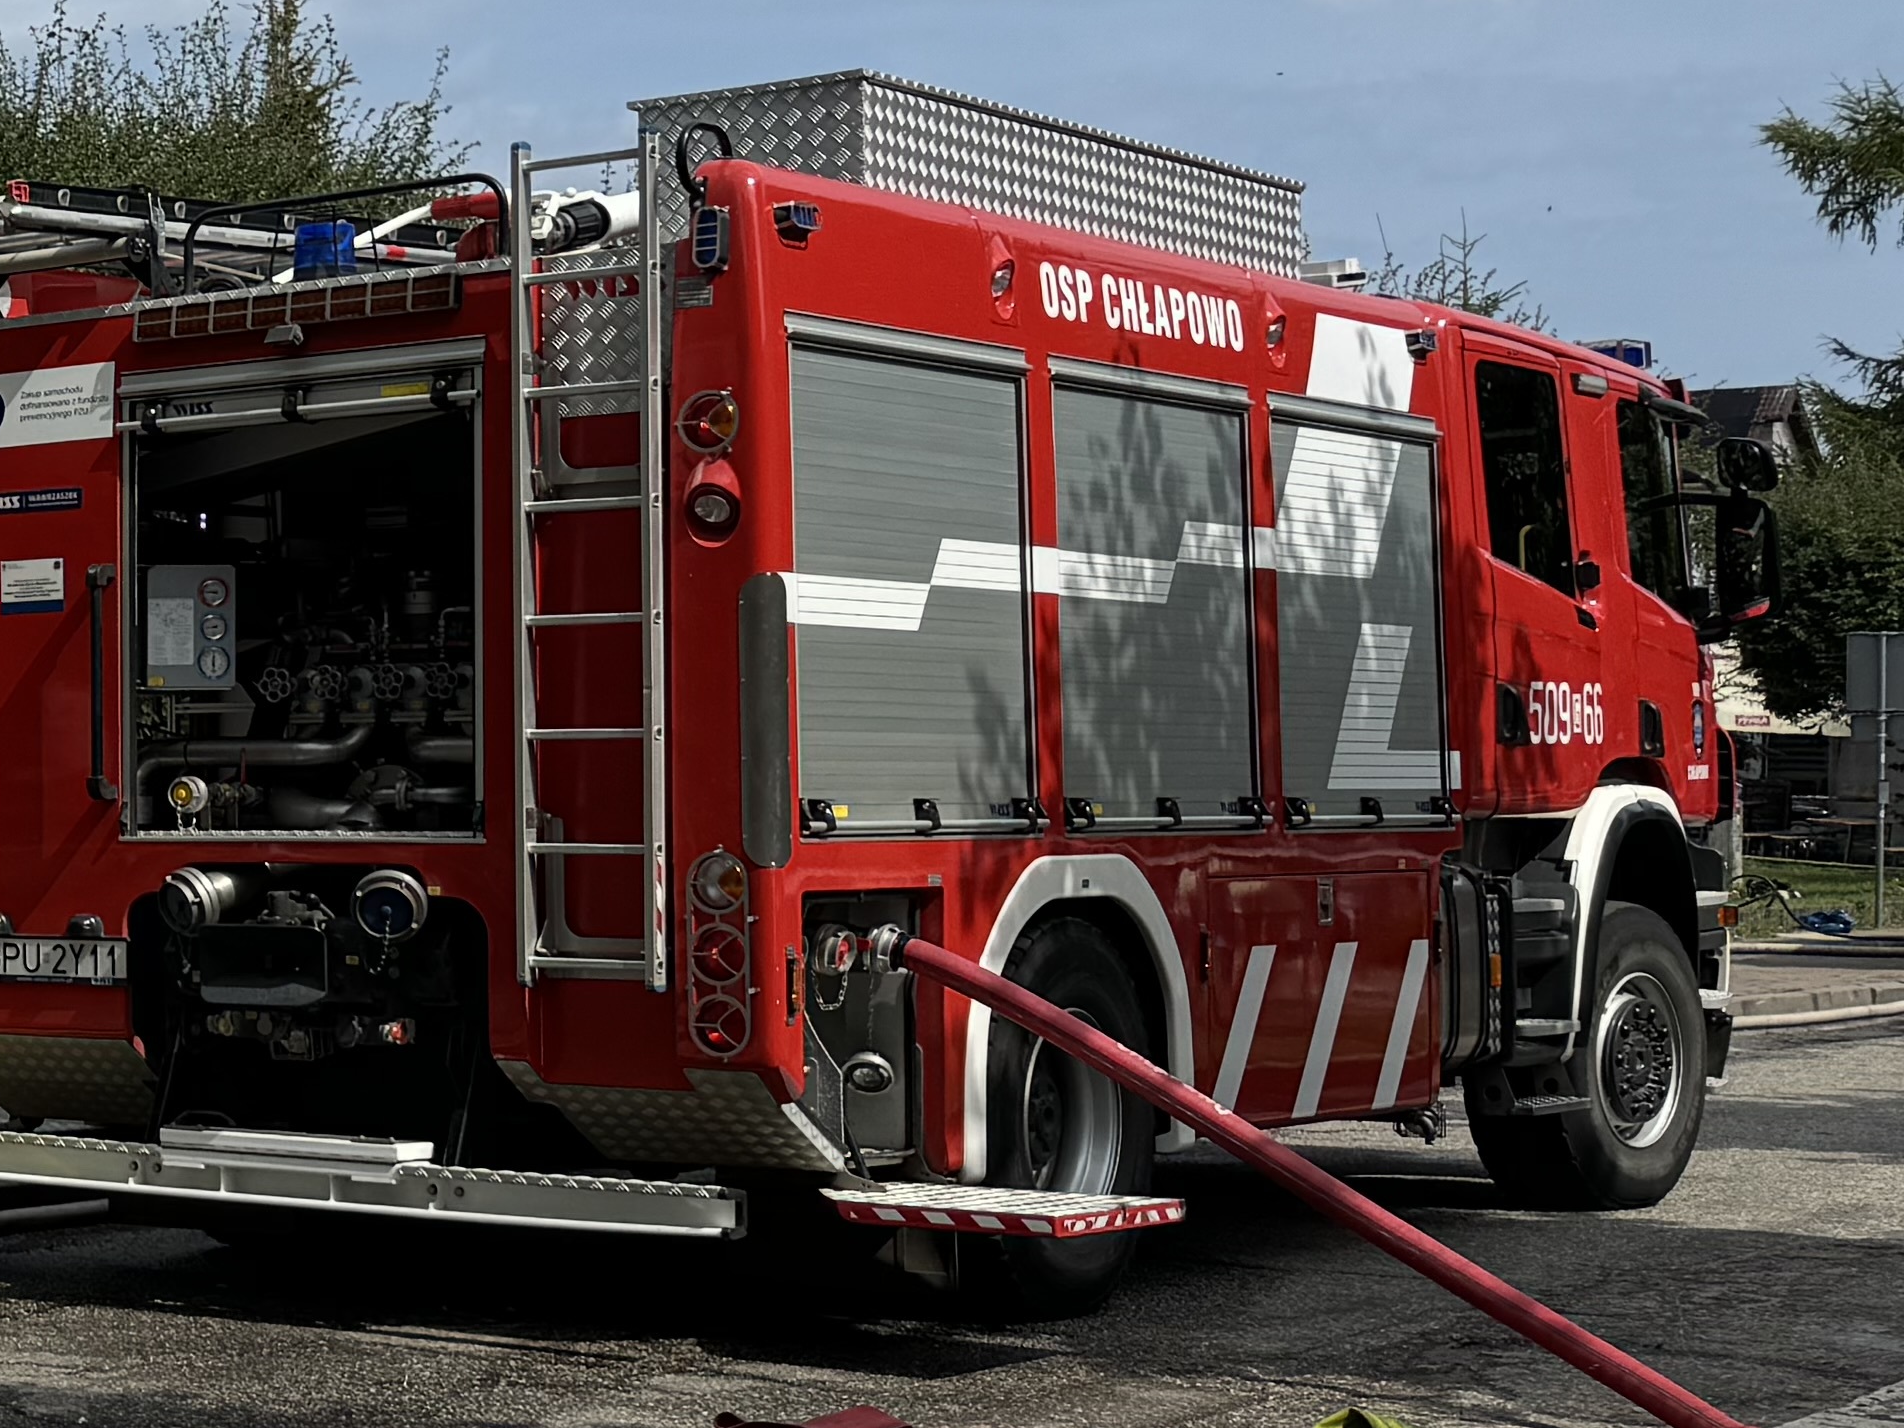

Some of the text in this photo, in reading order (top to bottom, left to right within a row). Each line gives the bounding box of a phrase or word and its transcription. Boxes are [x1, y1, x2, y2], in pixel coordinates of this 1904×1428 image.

[1040, 261, 1244, 352] OSP CHŁAPOWO
[52, 943, 116, 977] 2Y11
